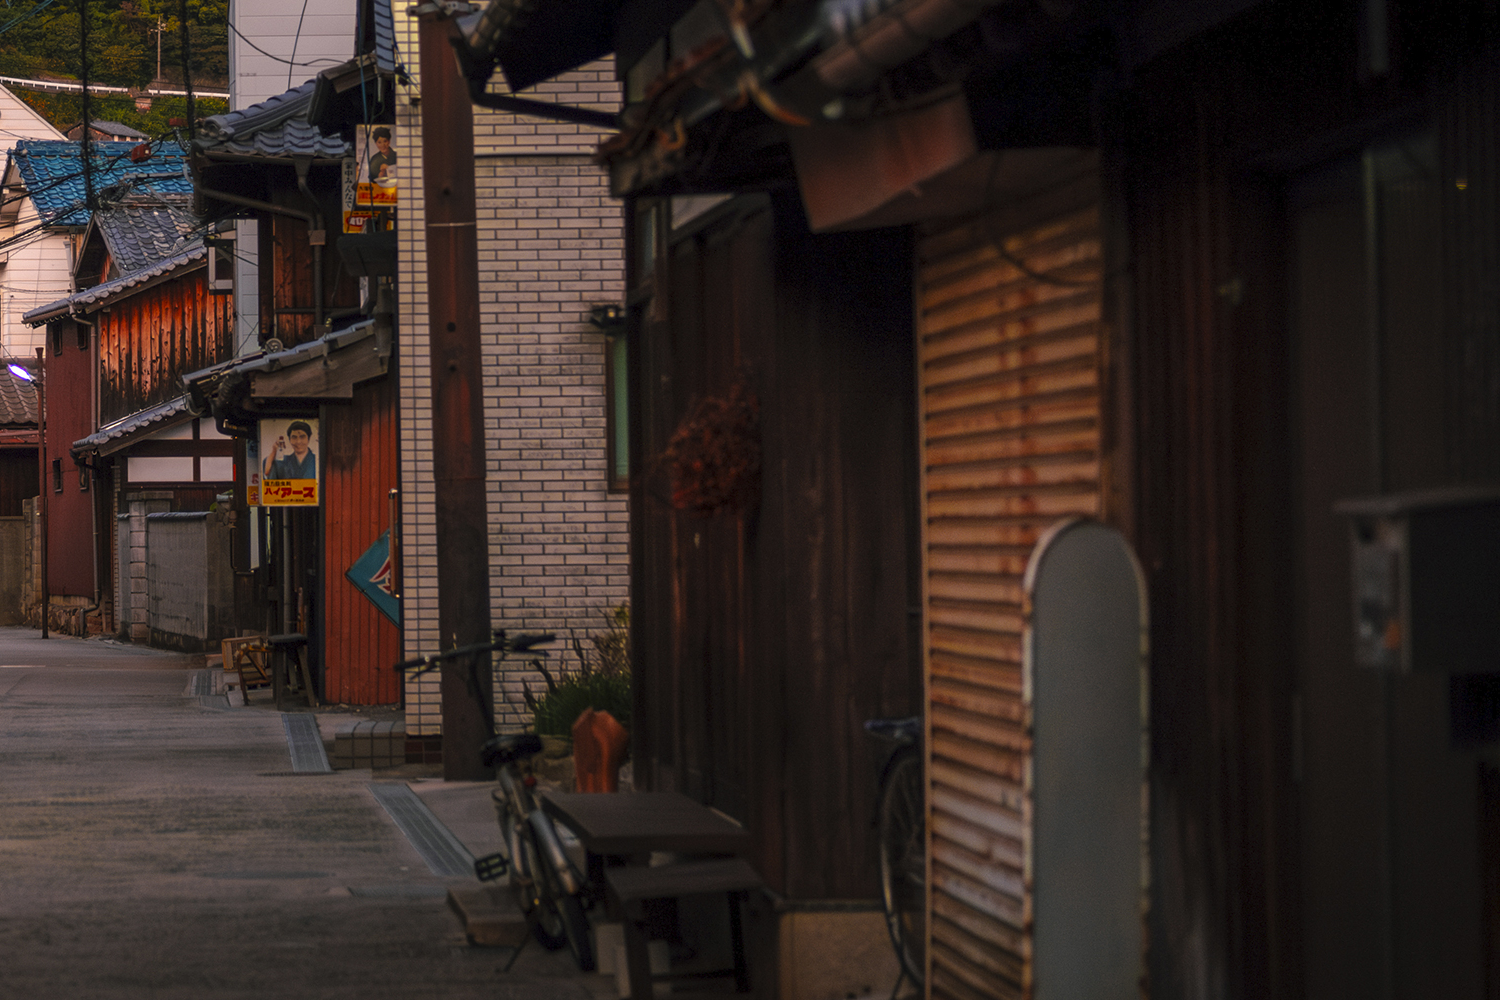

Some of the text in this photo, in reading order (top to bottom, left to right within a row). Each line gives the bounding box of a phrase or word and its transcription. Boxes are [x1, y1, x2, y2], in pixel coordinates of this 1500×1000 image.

[264, 487, 315, 498] ハイアース
